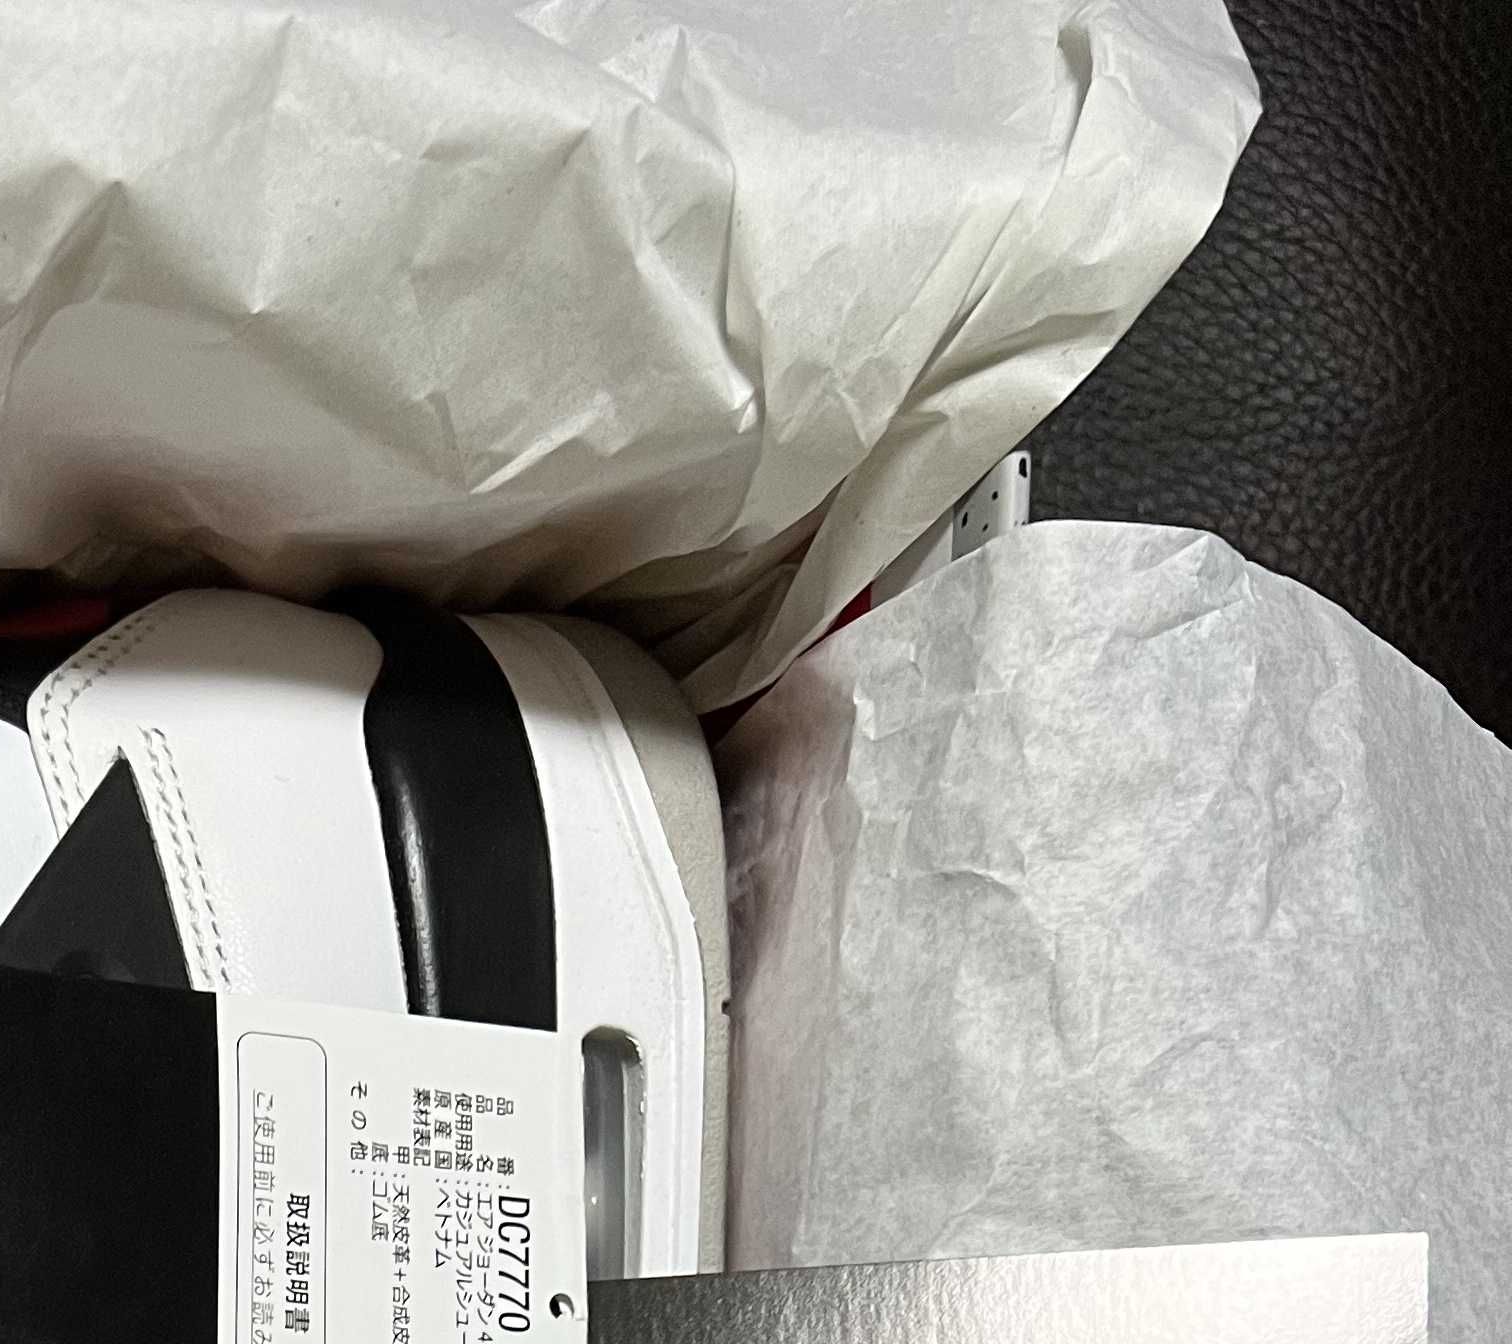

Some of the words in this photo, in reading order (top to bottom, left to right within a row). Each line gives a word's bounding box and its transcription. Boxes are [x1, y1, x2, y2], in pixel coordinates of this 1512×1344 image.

[413, 1088, 431, 1167] 素材表記
[284, 1193, 311, 1334] 取扱説明書
